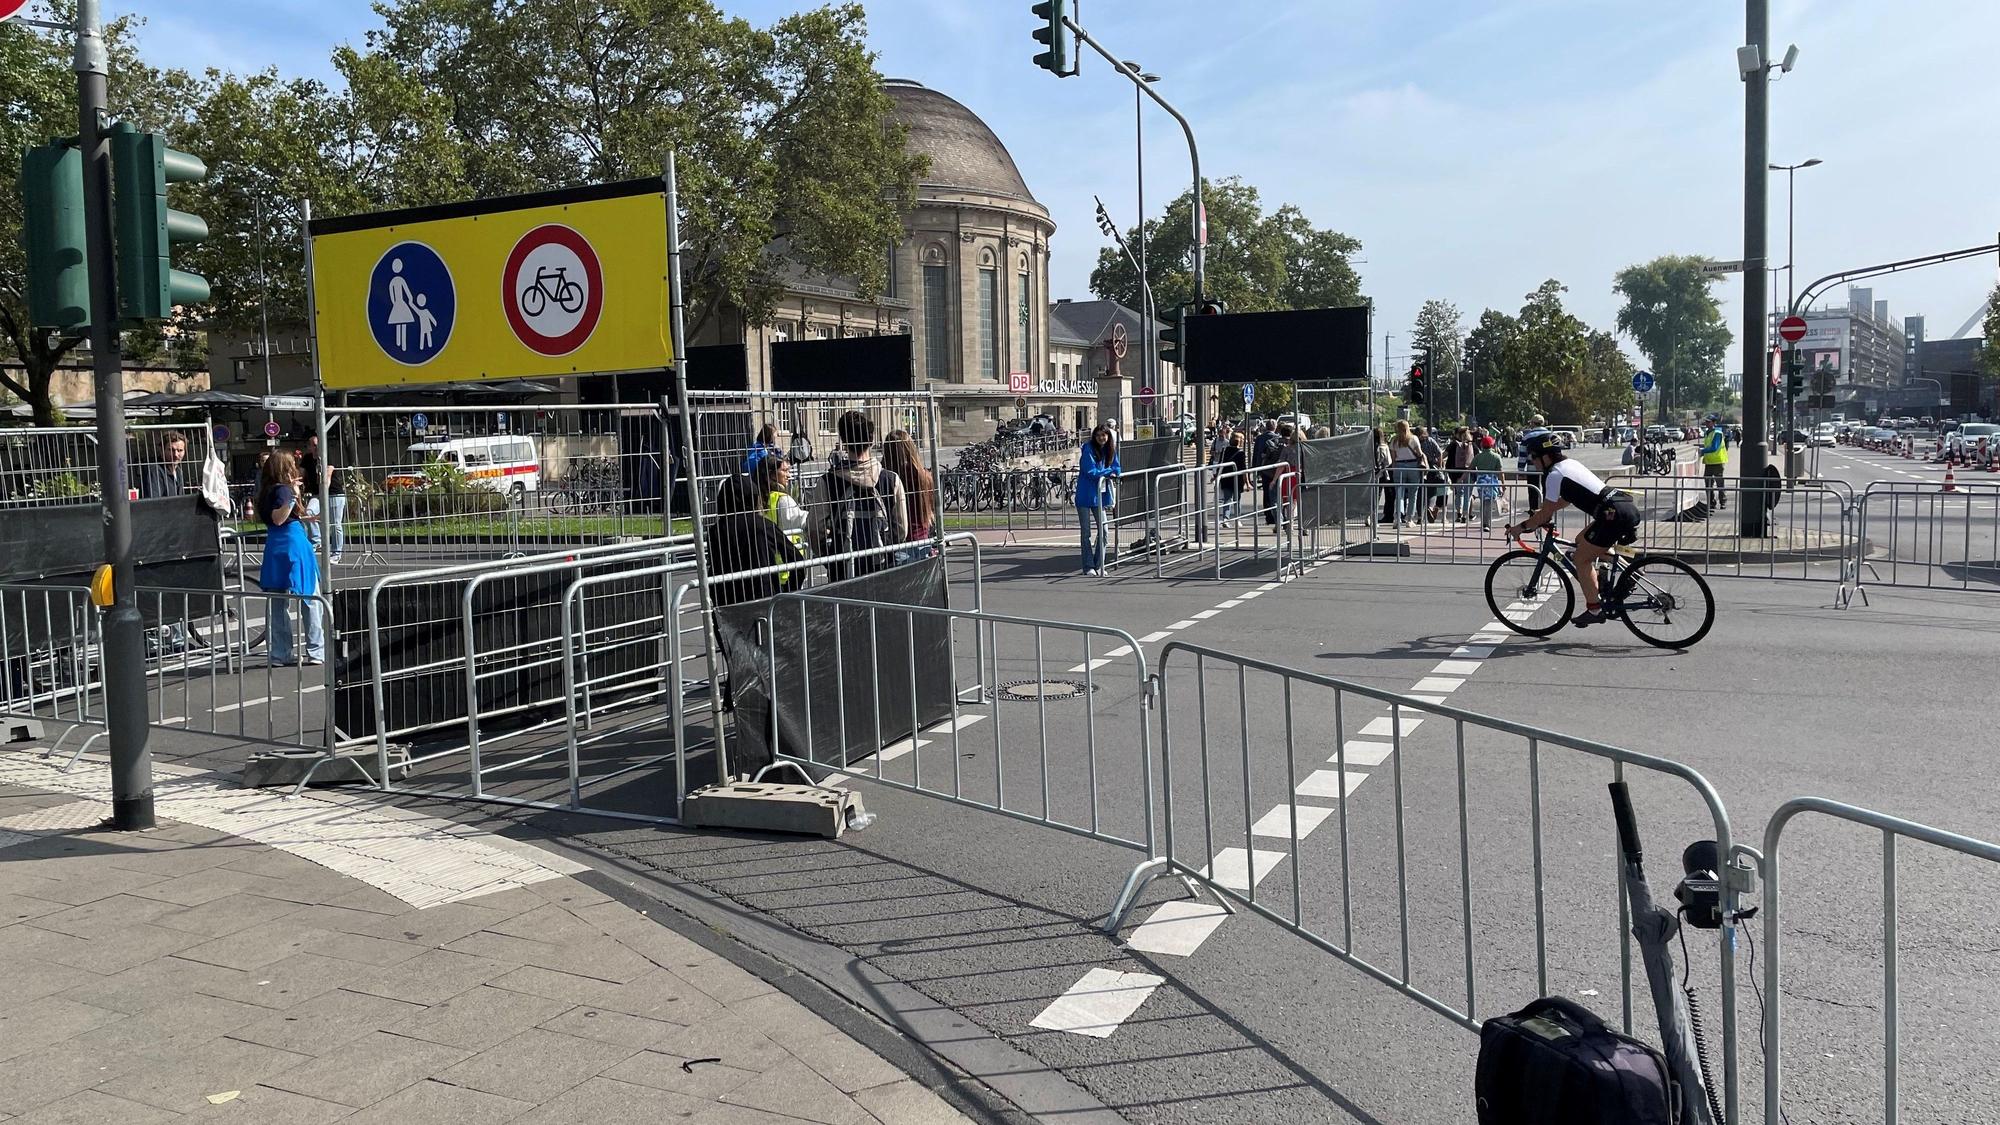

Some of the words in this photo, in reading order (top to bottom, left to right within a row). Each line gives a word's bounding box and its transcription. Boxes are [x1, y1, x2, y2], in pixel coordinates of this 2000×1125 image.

[1703, 264, 1738, 272] Auenweg
[1012, 376, 1028, 389] DB
[1039, 379, 1067, 394] KÖLN
